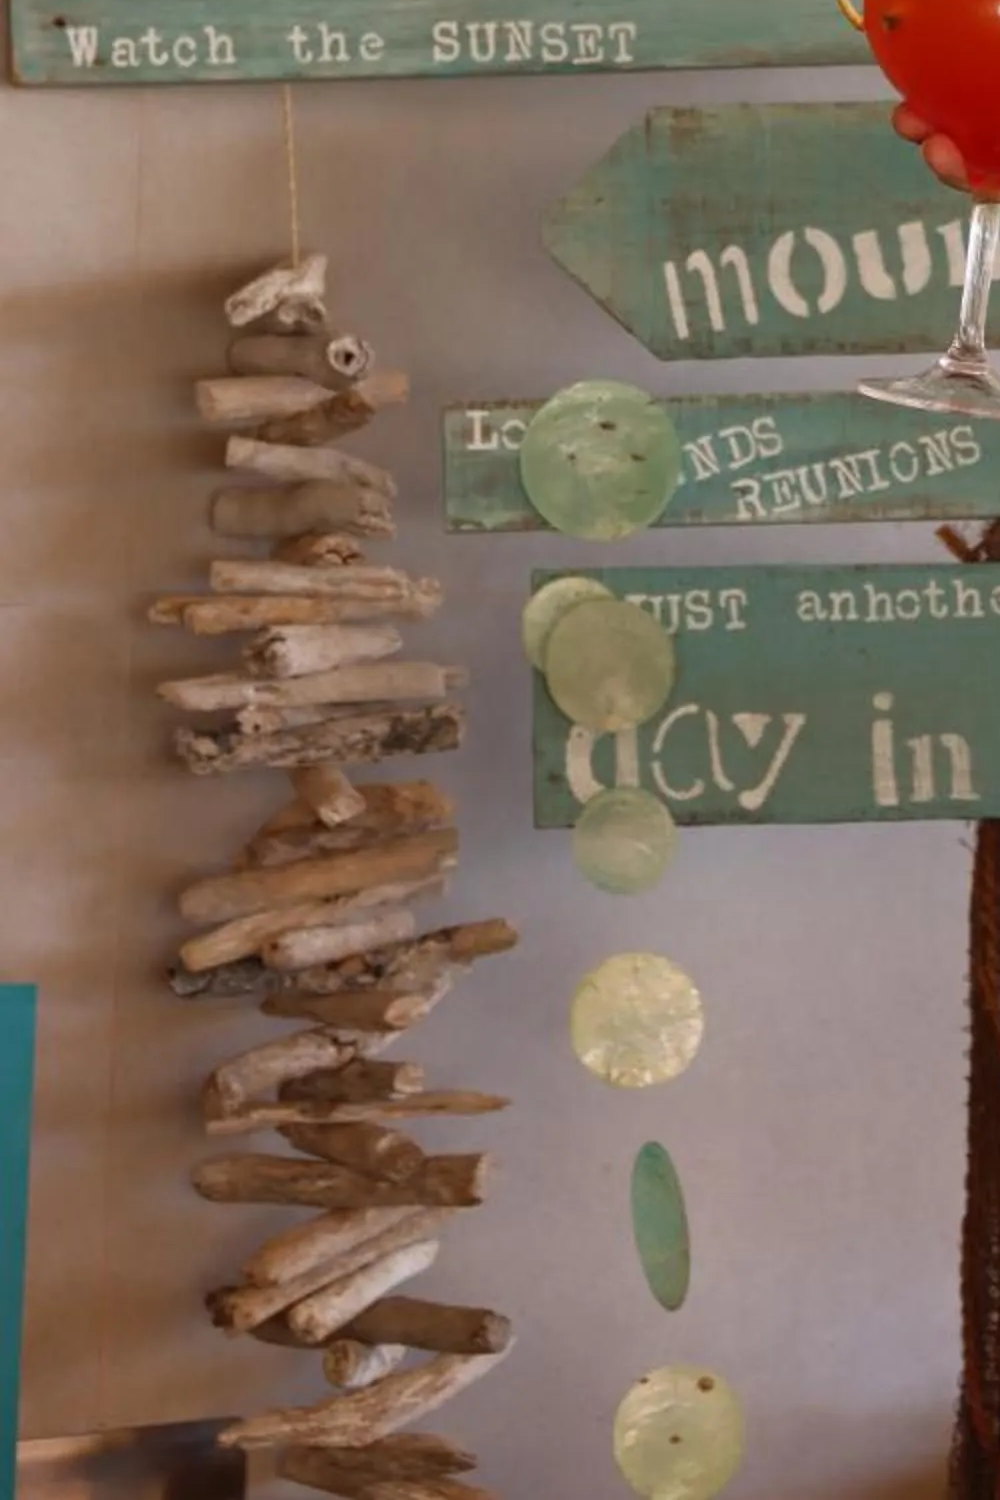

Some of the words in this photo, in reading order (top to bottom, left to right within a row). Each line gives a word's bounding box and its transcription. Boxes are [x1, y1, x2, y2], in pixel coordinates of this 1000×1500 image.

[66, 22, 236, 67] Watch
[287, 23, 386, 63] the
[431, 19, 639, 65] SUNSET
[729, 425, 981, 520] REUNIONS
[872, 691, 981, 807] in
